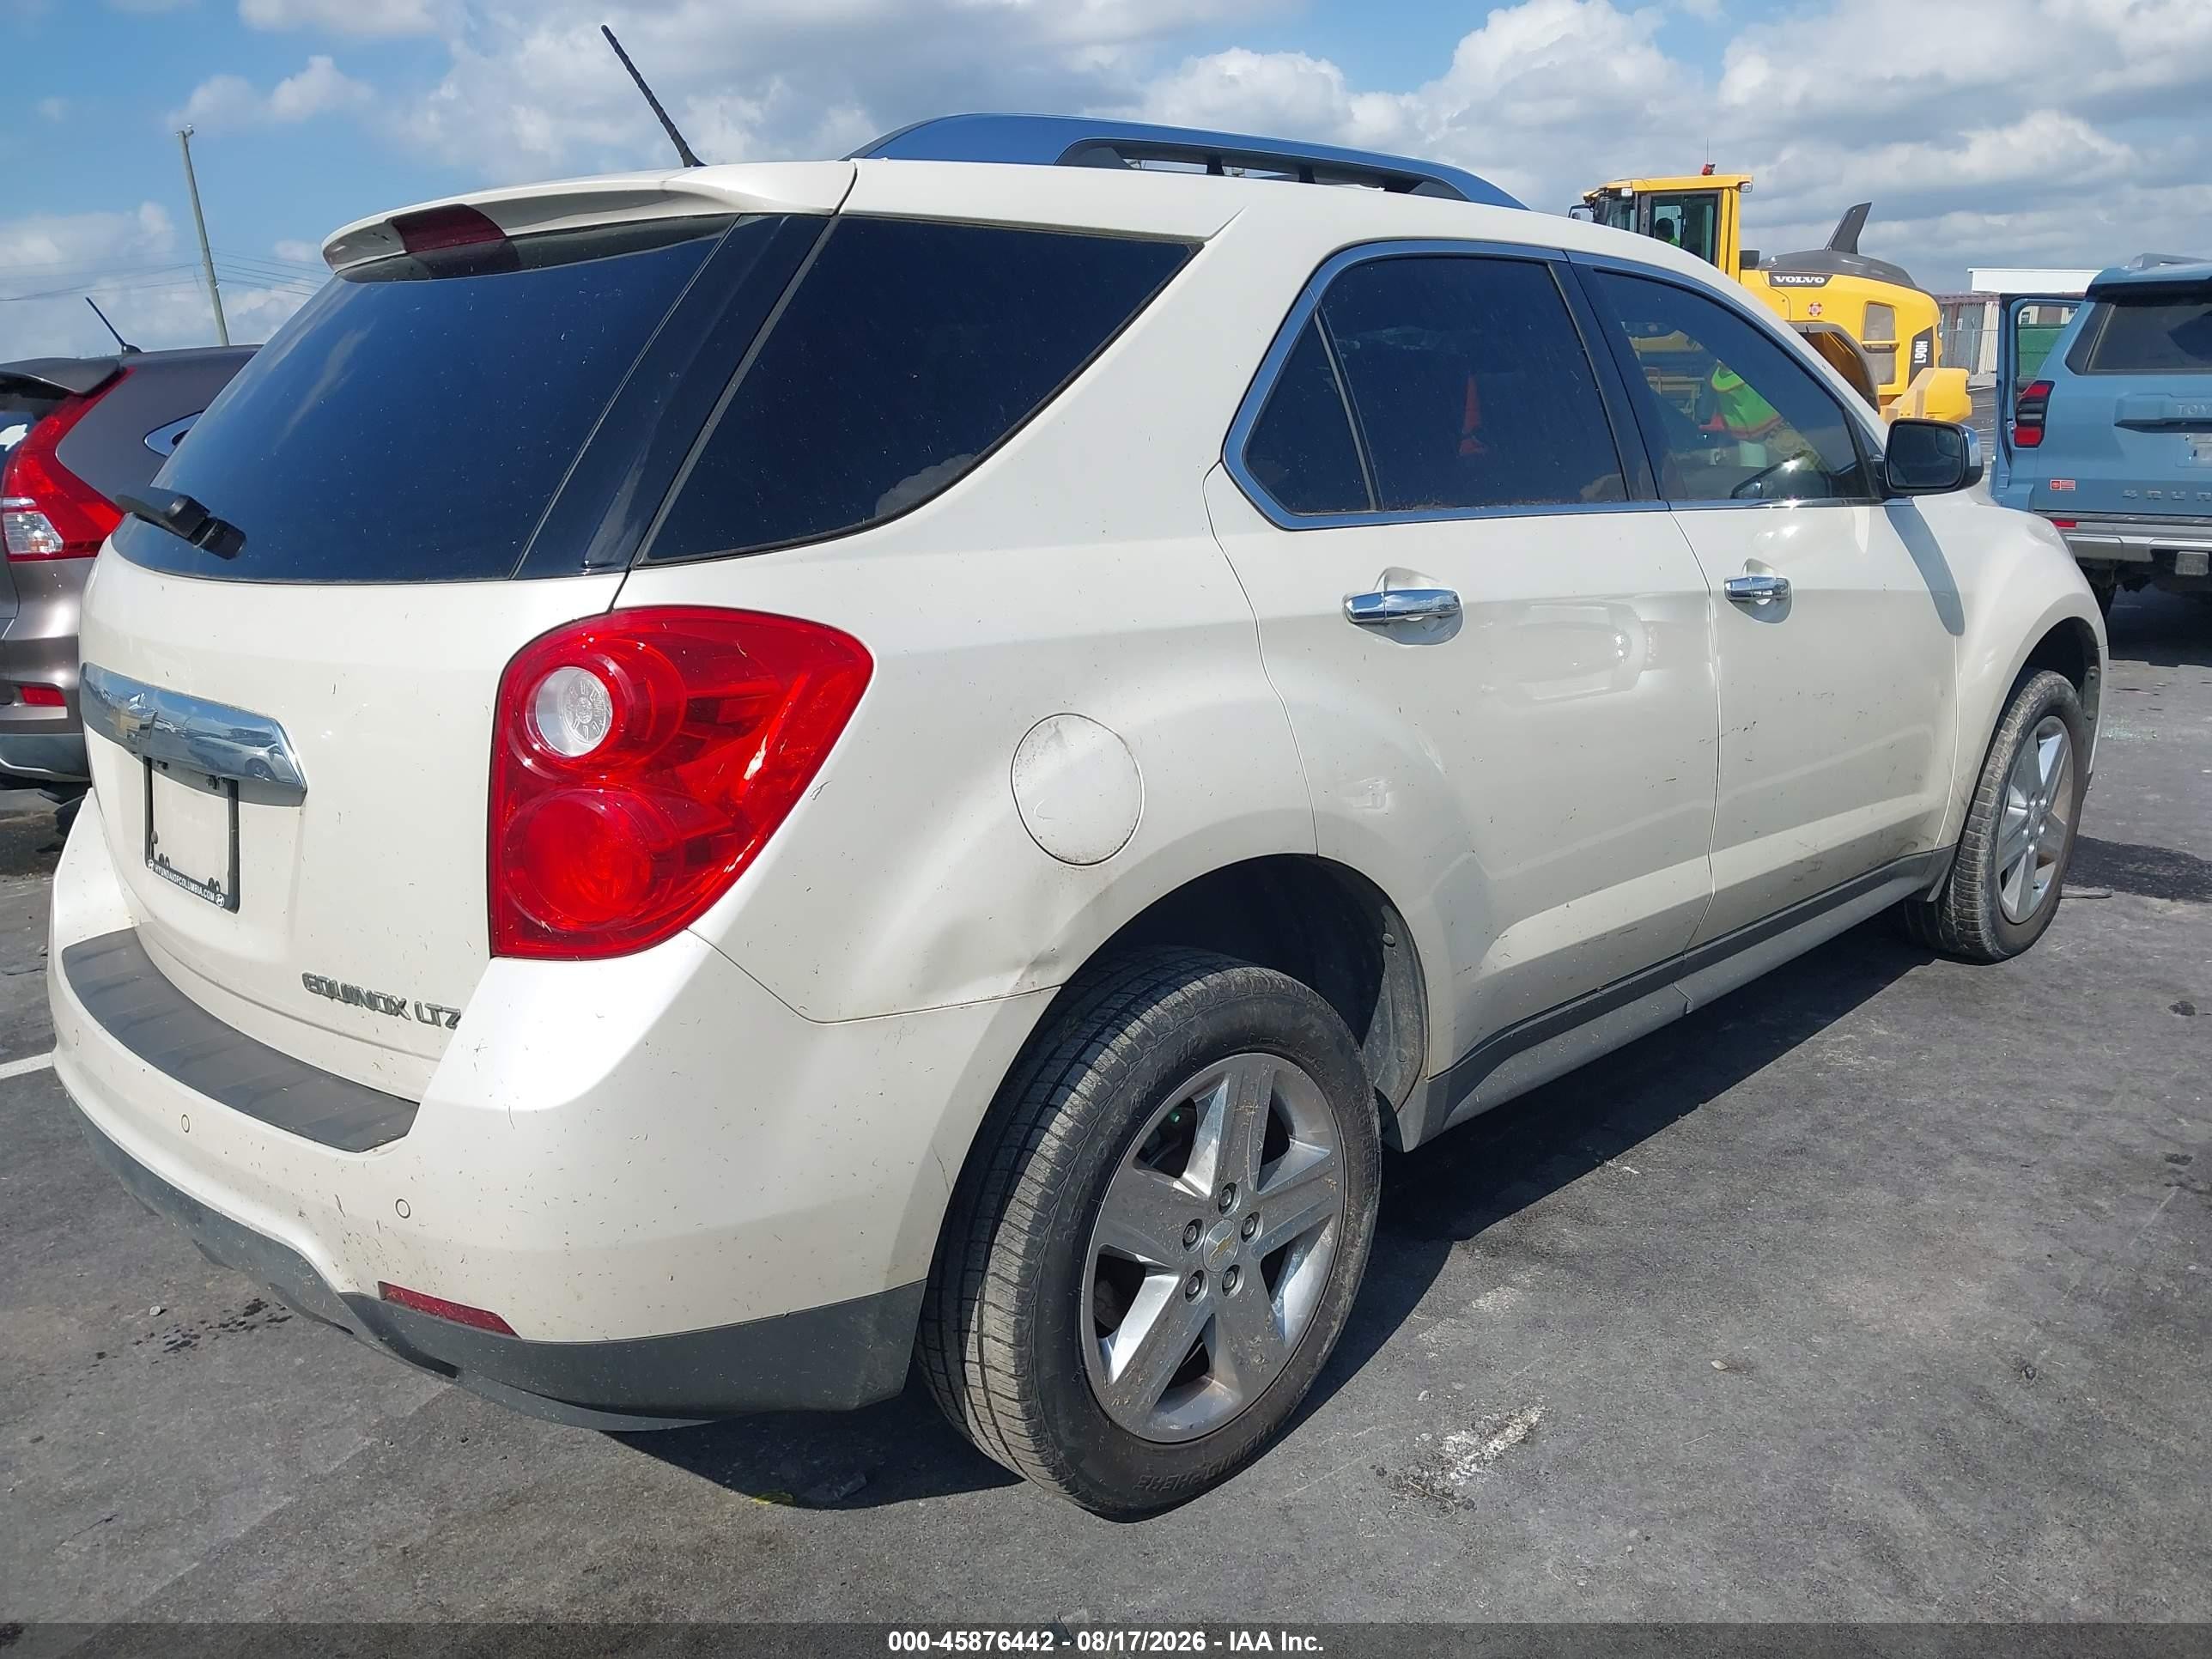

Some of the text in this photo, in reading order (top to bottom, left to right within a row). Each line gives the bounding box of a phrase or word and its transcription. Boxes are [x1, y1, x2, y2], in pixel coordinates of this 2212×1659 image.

[1914, 341, 1929, 364] L90H
[301, 972, 461, 1030] EQUINOX LTZ
